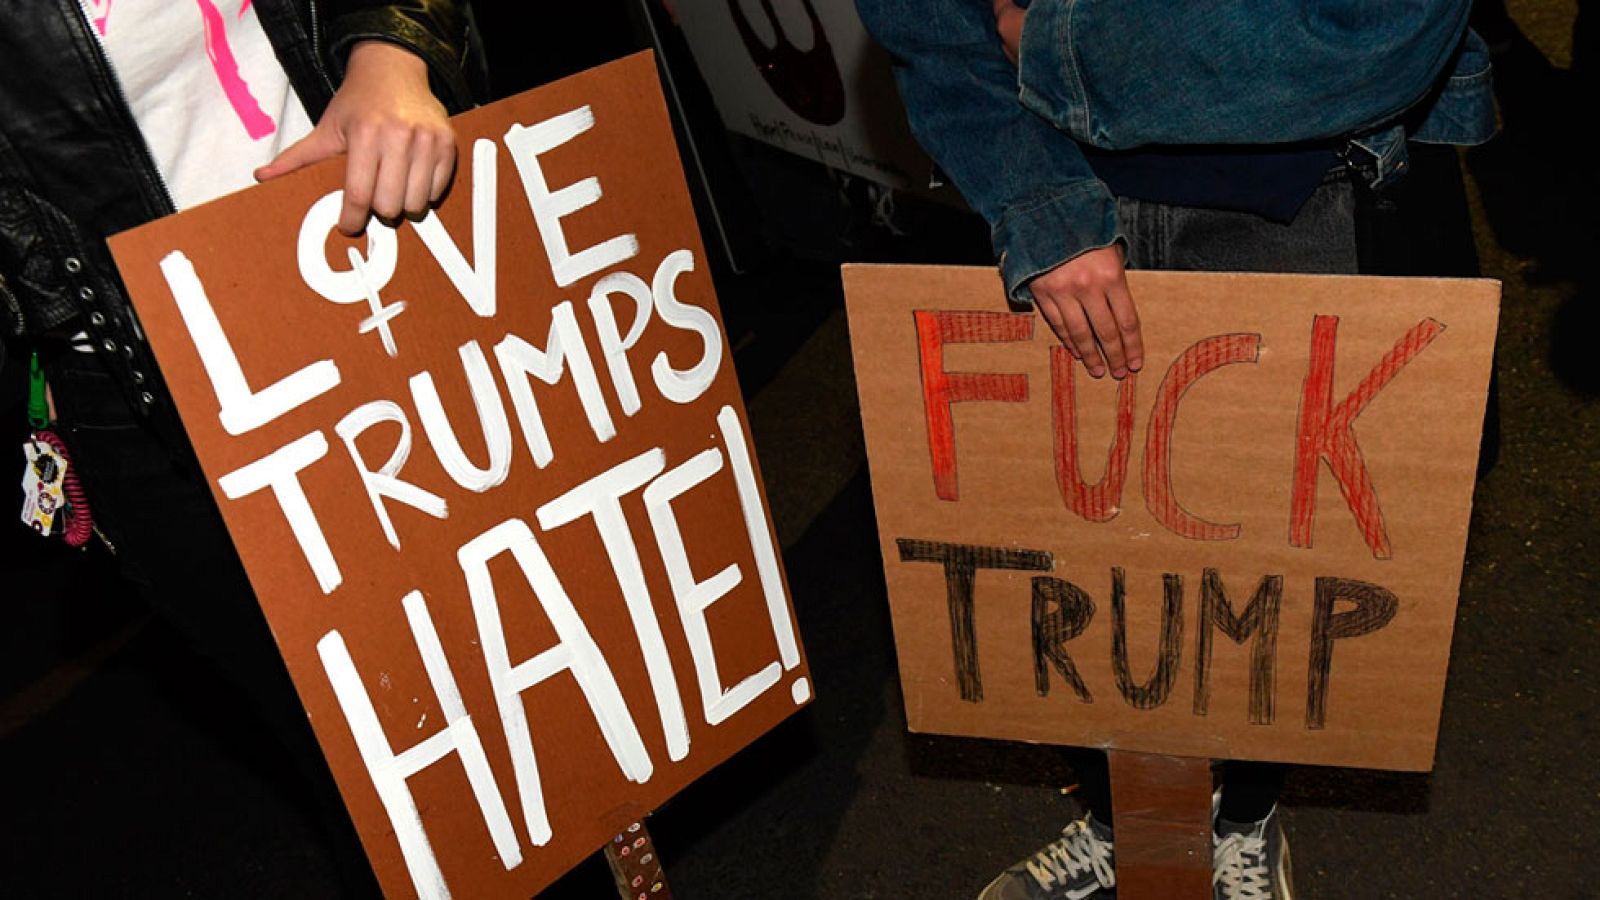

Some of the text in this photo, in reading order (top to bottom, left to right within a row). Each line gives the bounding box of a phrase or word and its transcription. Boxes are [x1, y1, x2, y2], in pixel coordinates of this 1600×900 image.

[159, 105, 639, 436] LOVE
[218, 249, 723, 594] TRUMPS
[913, 309, 1447, 560] FUCK
[316, 404, 811, 900] HATE!
[896, 538, 1400, 730] TRUMP
